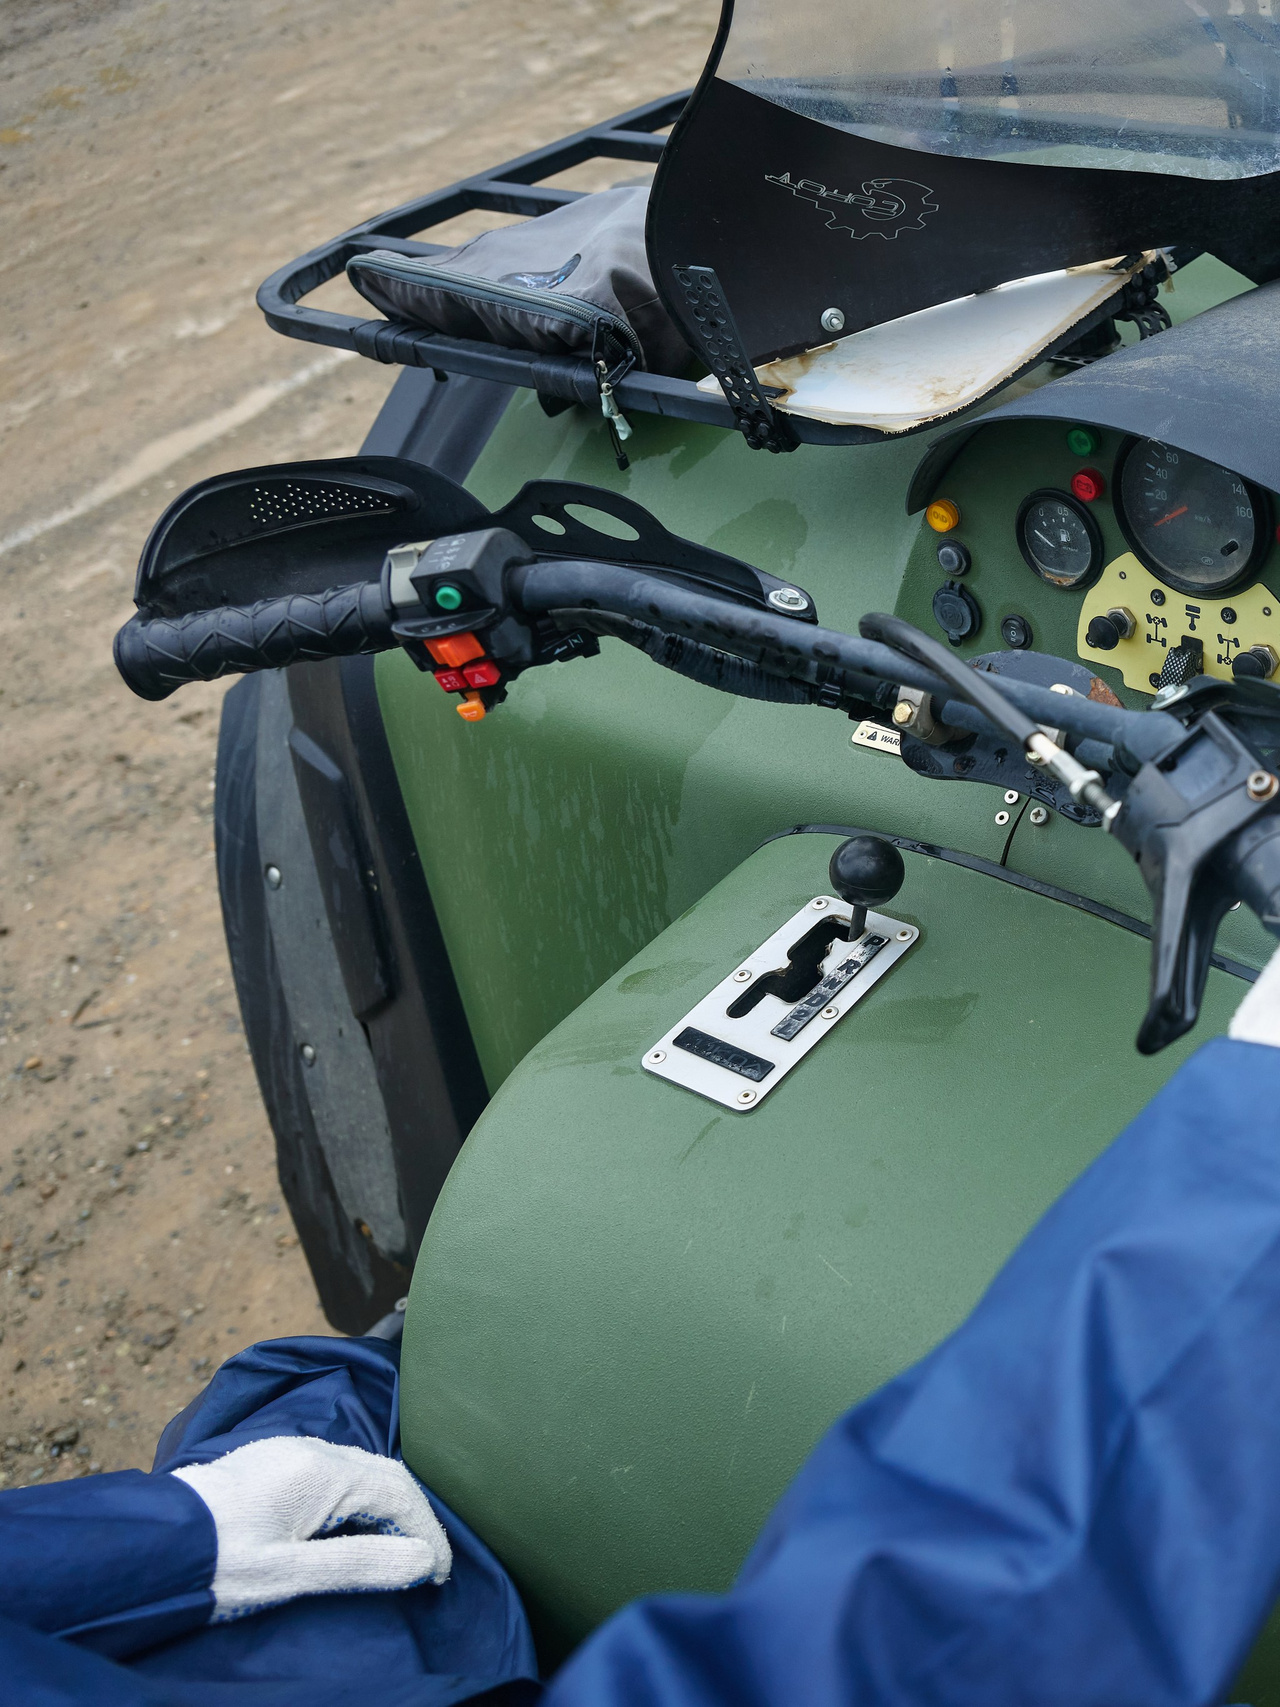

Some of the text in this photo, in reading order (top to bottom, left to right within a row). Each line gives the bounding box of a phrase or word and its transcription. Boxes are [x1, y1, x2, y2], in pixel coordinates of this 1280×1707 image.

[1165, 453, 1179, 465] 60
[1155, 469, 1168, 480] 40
[1155, 489, 1168, 501] 20
[1235, 506, 1253, 519] 160
[880, 735, 901, 747] WAR
[863, 935, 885, 948] P
[837, 958, 862, 975] R
